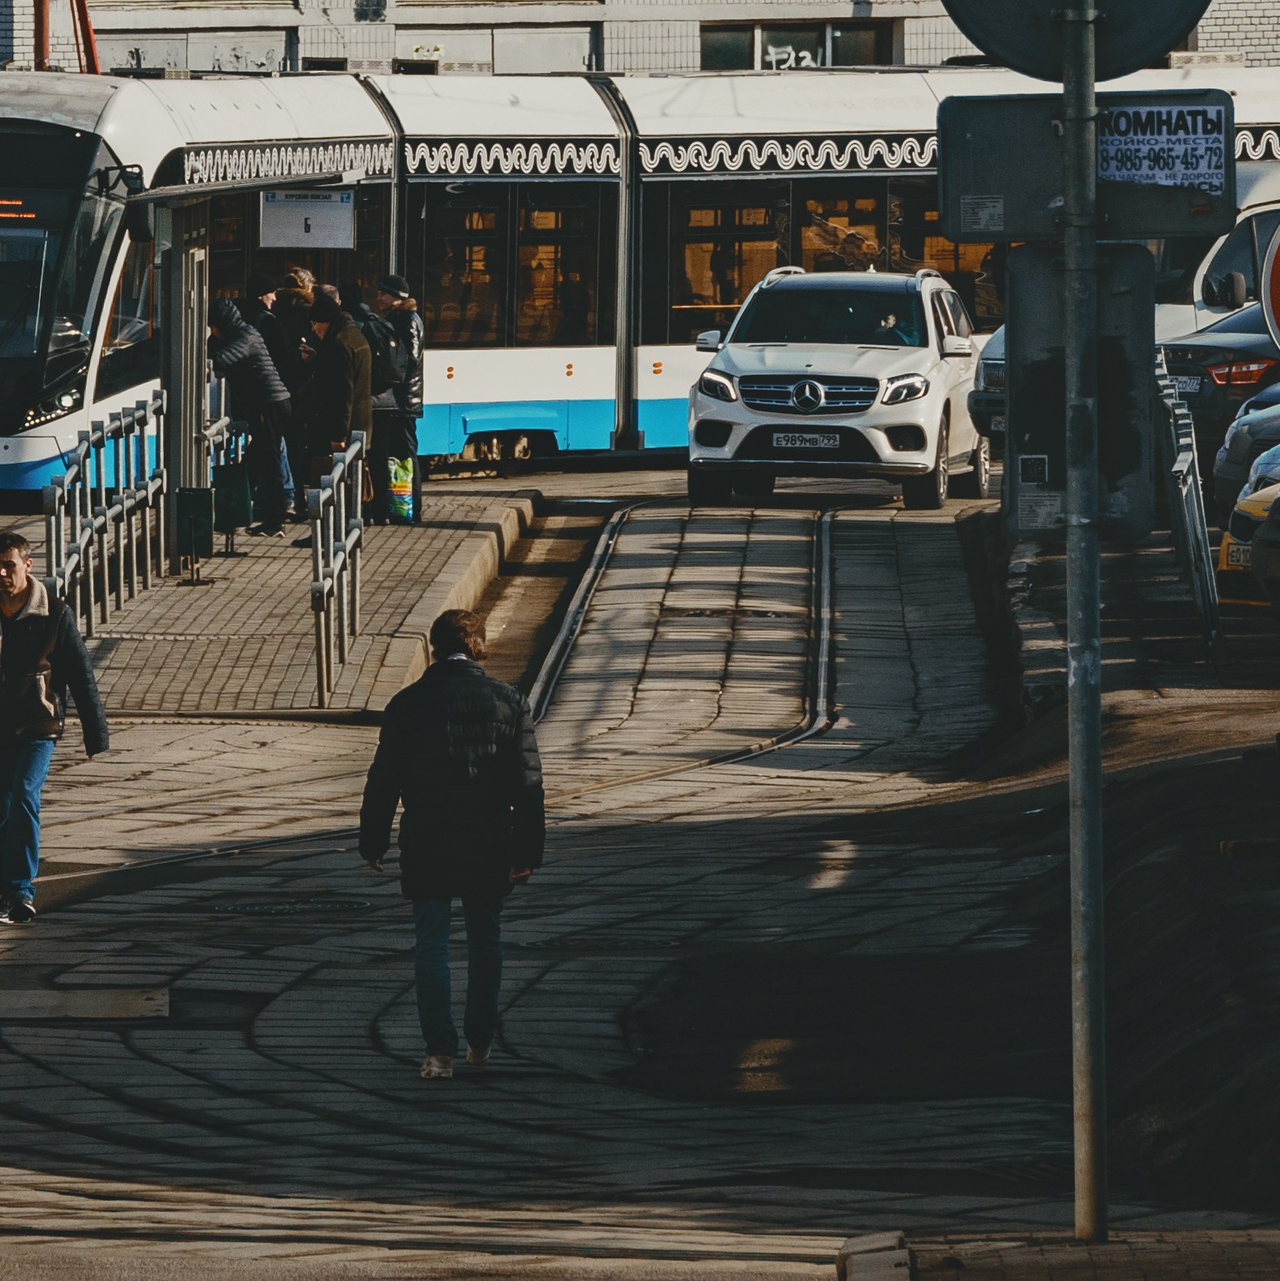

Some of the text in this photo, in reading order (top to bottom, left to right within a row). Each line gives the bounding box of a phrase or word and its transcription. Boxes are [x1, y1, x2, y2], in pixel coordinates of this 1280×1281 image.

[1100, 109, 1222, 136] КОМНАТЫ
[1100, 137, 1222, 147] КОЙКО-МЕСТА
[1100, 147, 1223, 172] 8-985-965-45-72
[1165, 172, 1178, 180] НЕ
[1181, 172, 1224, 181] ДОРОГО
[304, 217, 311, 233] Б
[775, 435, 838, 446] Е989МВ 799
